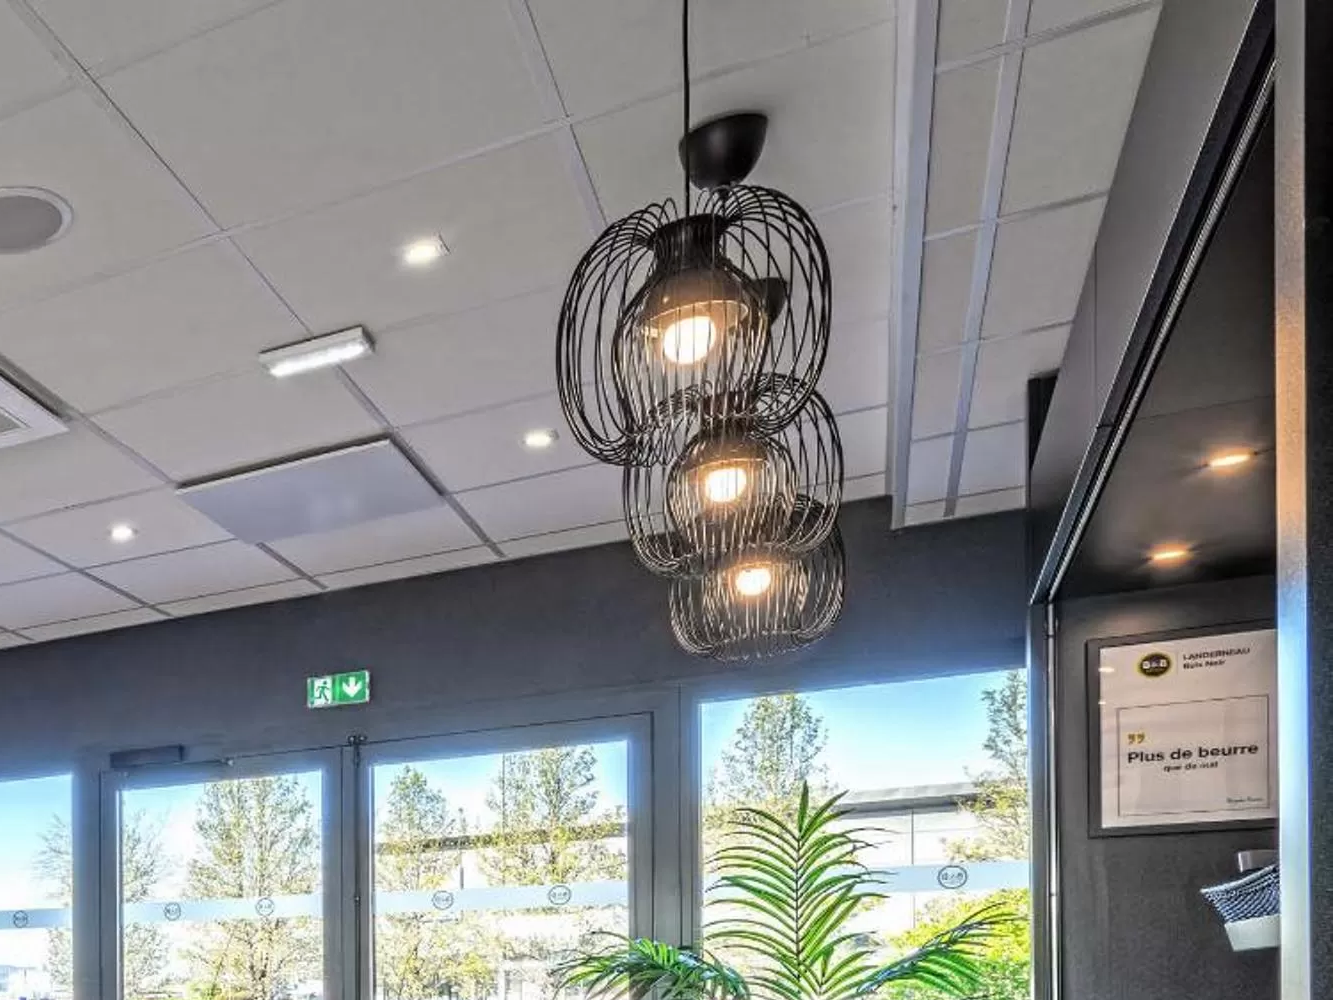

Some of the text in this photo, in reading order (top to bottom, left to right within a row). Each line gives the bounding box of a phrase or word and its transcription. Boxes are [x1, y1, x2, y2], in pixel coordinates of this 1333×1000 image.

[1182, 647, 1251, 661] LANDERNEAU
[1127, 744, 1259, 763] Plus de beurre
